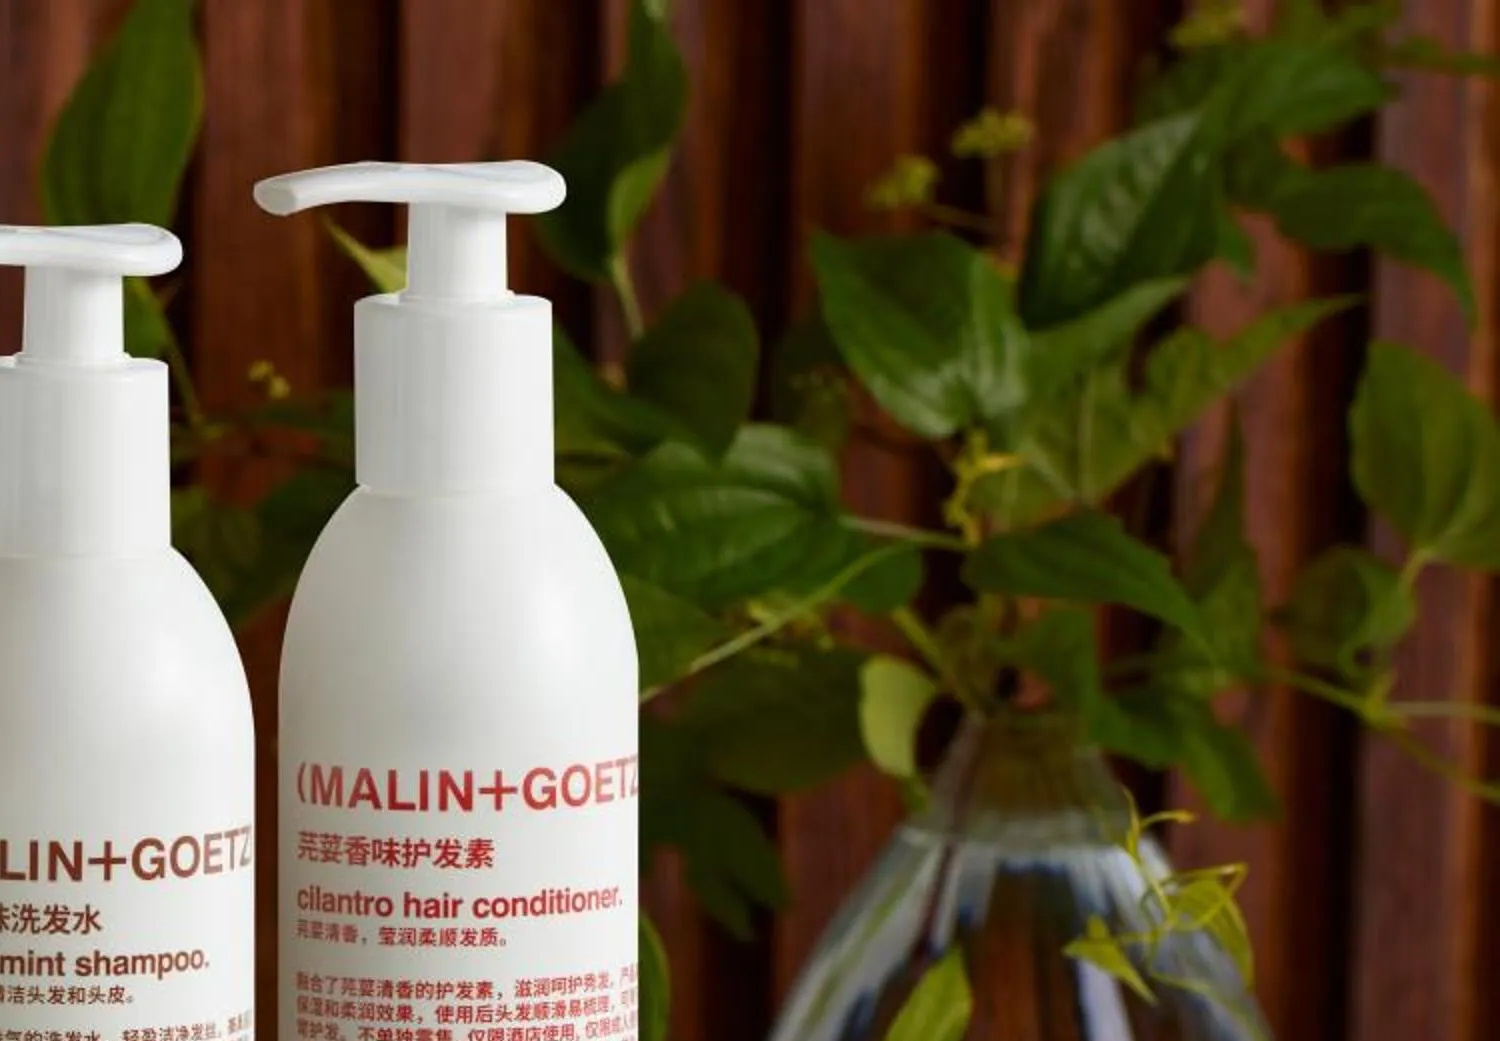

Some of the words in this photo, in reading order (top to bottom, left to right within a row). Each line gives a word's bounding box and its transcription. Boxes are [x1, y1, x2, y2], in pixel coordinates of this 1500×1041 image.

[298, 831, 494, 869] 芫荽香味护发素
[297, 885, 394, 918] cilantro
[402, 892, 460, 919] hair
[472, 886, 623, 919] conditioner.
[75, 949, 210, 980] shampoo.
